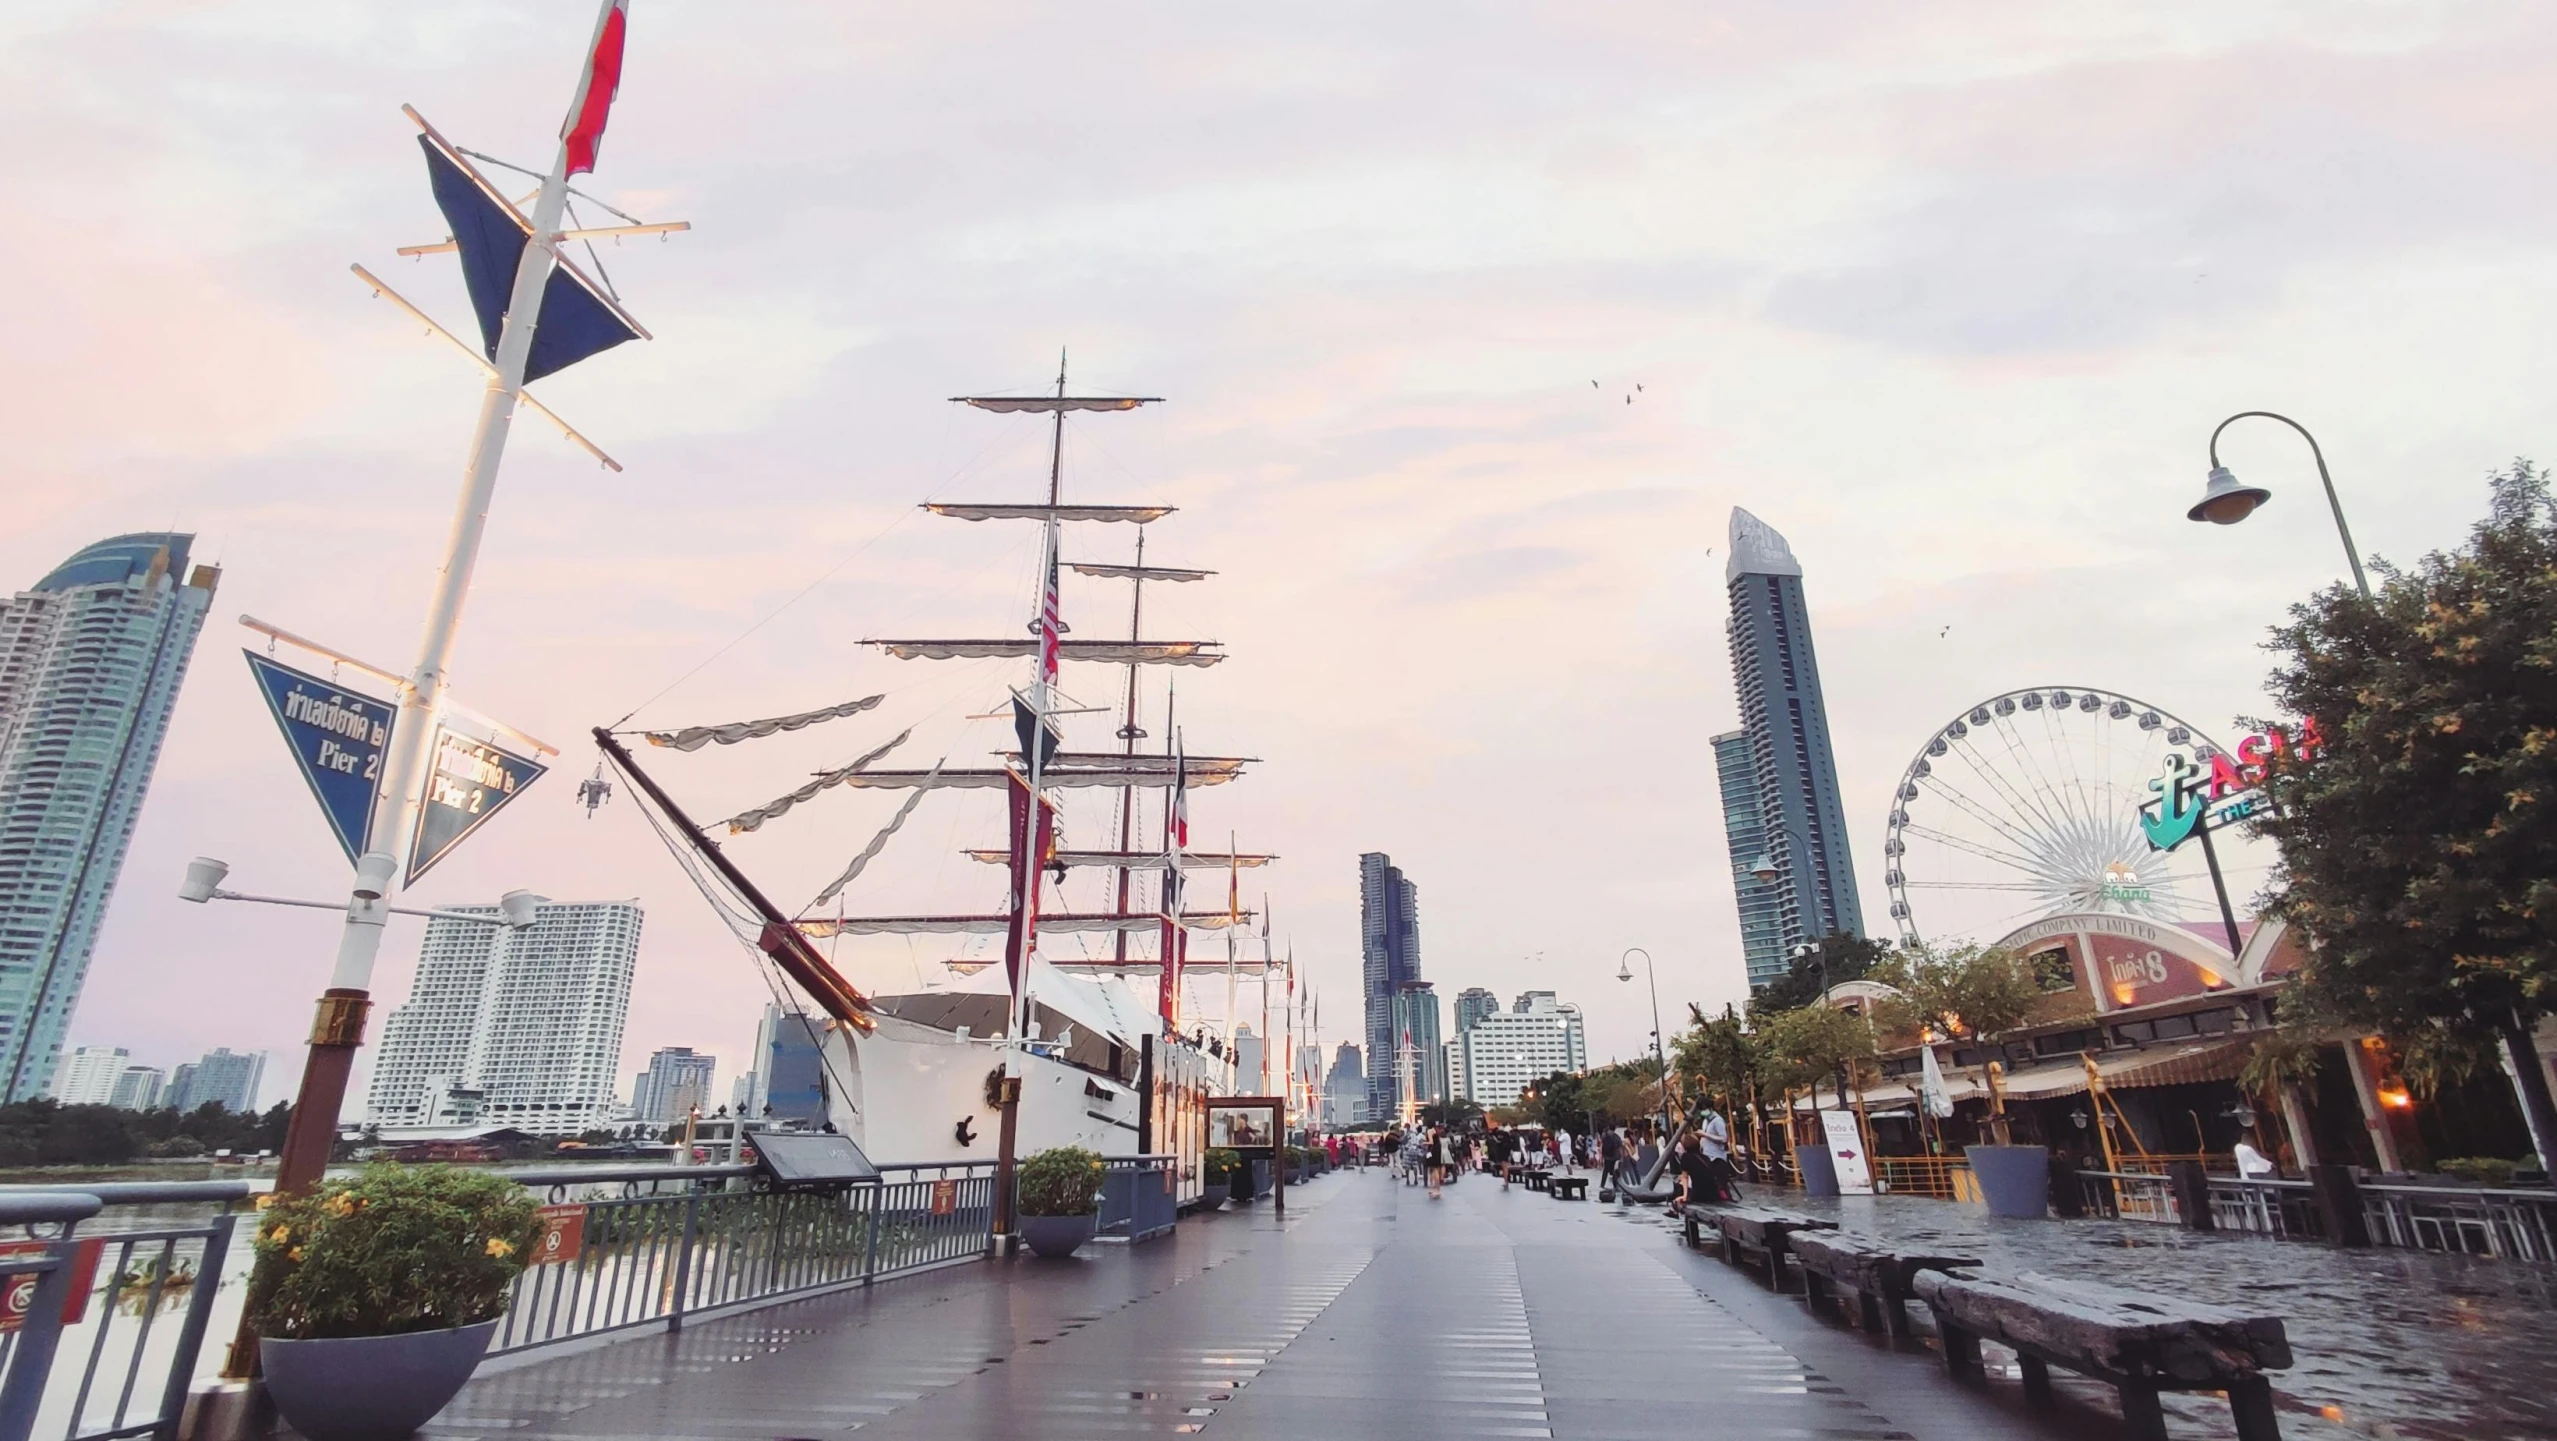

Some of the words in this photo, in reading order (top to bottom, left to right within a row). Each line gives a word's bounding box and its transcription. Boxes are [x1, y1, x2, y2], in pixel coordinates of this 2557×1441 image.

[316, 739, 358, 774] Pier
[364, 754, 379, 780] 2
[431, 776, 467, 808] Pier
[468, 789, 482, 814] 2
[2215, 799, 2252, 822] THE
[2101, 884, 2150, 903] Chang
[2002, 928, 2037, 949] SIATIC
[2038, 917, 2088, 935] COMPANY
[2096, 918, 2156, 941] LIMITED
[2146, 951, 2167, 983] 8
